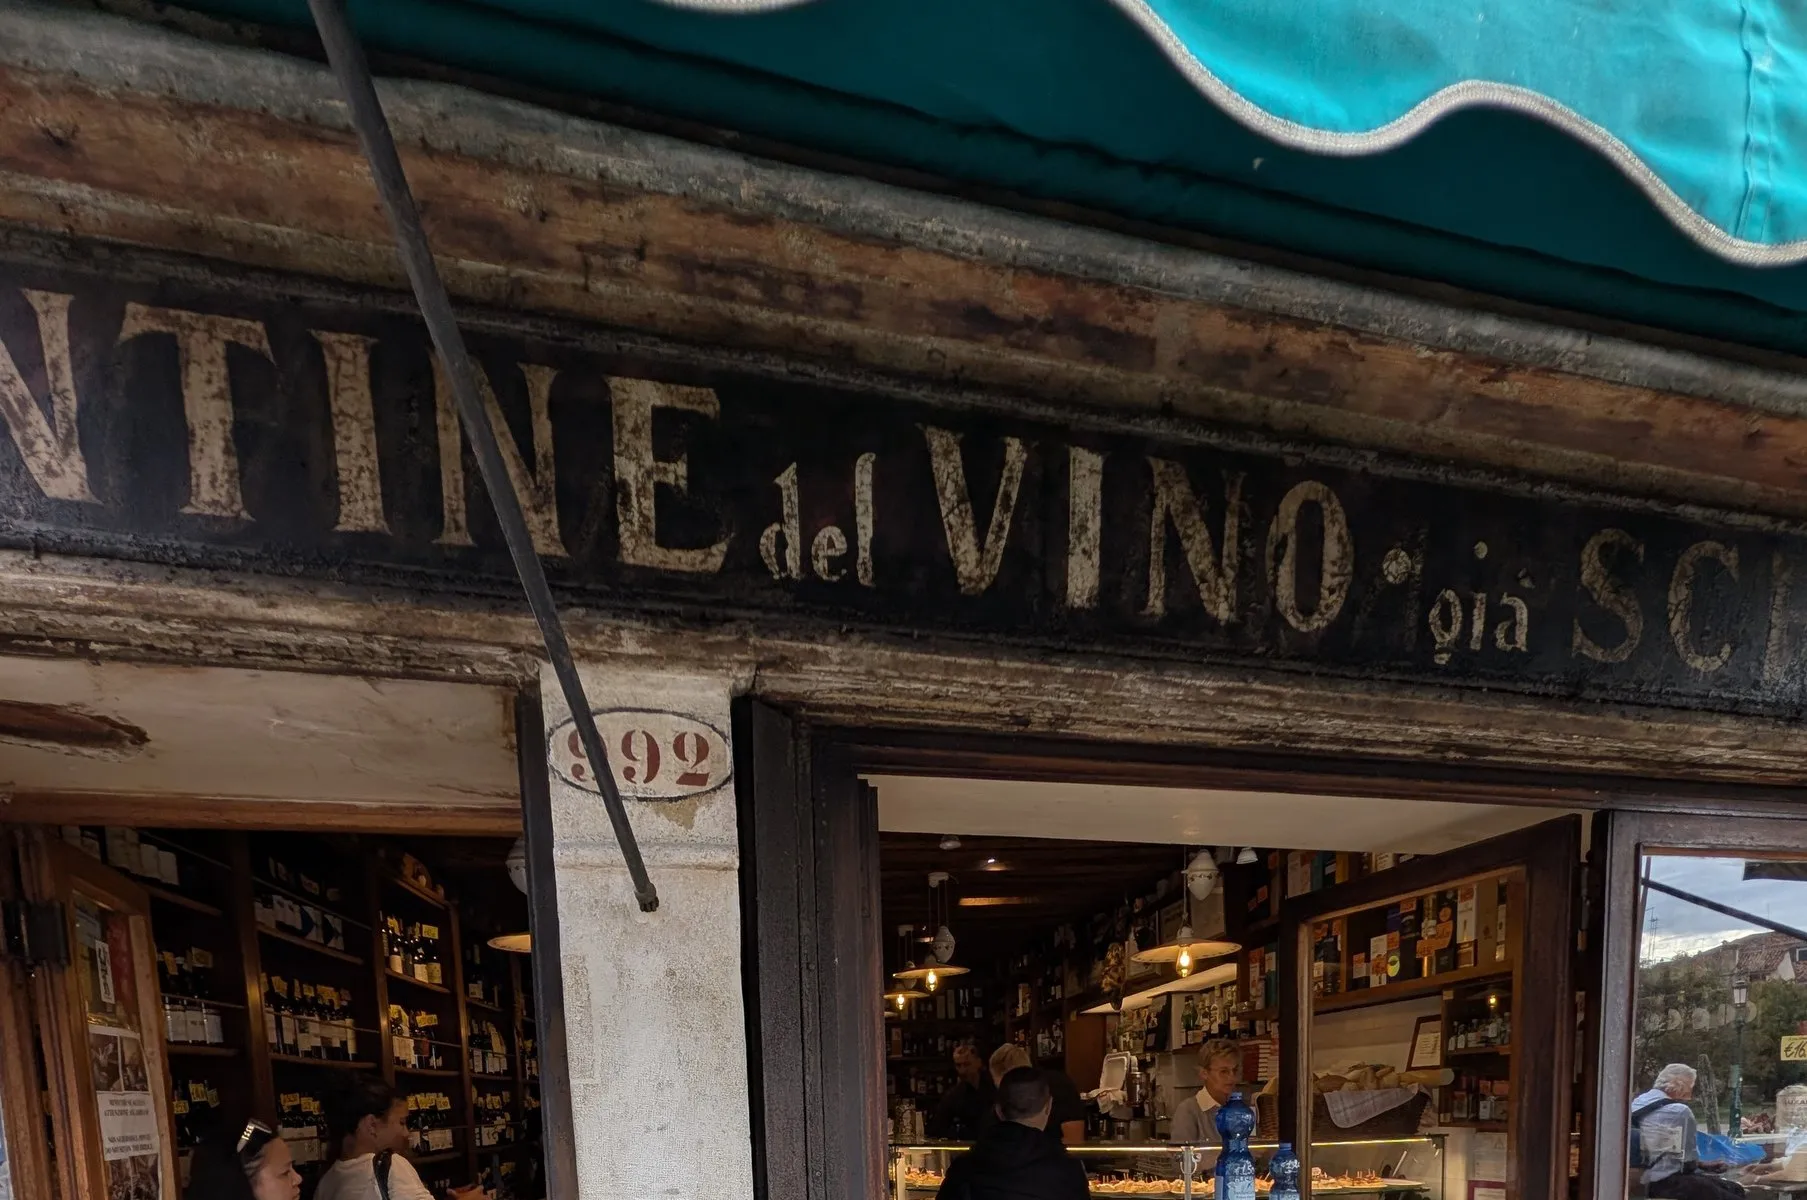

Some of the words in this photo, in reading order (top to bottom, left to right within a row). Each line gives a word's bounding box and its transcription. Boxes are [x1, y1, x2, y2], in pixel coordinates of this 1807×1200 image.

[0, 288, 736, 574] NTINE
[759, 452, 876, 587] del
[915, 424, 1355, 633] VINO
[1429, 541, 1530, 665] già
[567, 729, 711, 787] 992
